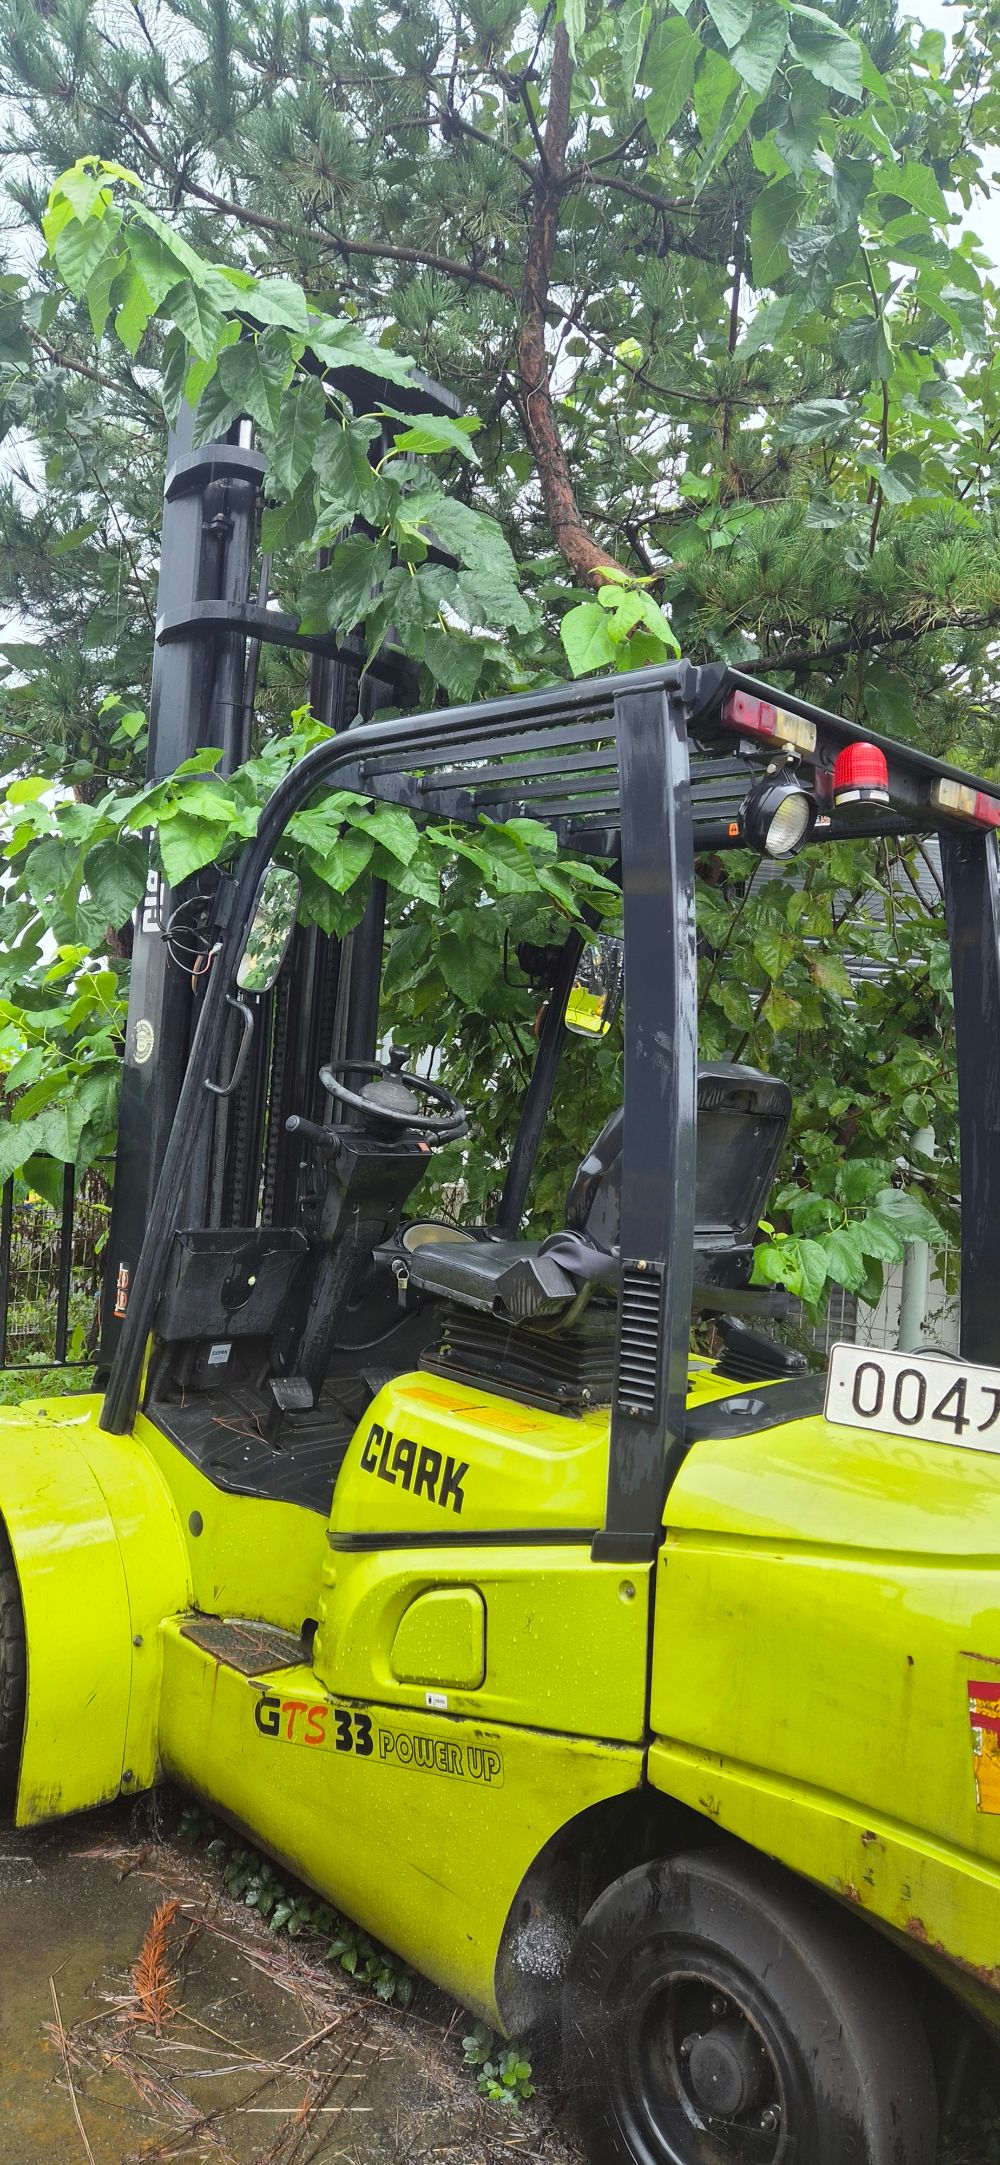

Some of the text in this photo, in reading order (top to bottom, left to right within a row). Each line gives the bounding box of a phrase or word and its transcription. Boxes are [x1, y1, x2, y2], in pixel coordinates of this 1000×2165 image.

[360, 1422, 470, 1515] CLARK
[254, 1696, 501, 1782] GTS 33 POWER UP
